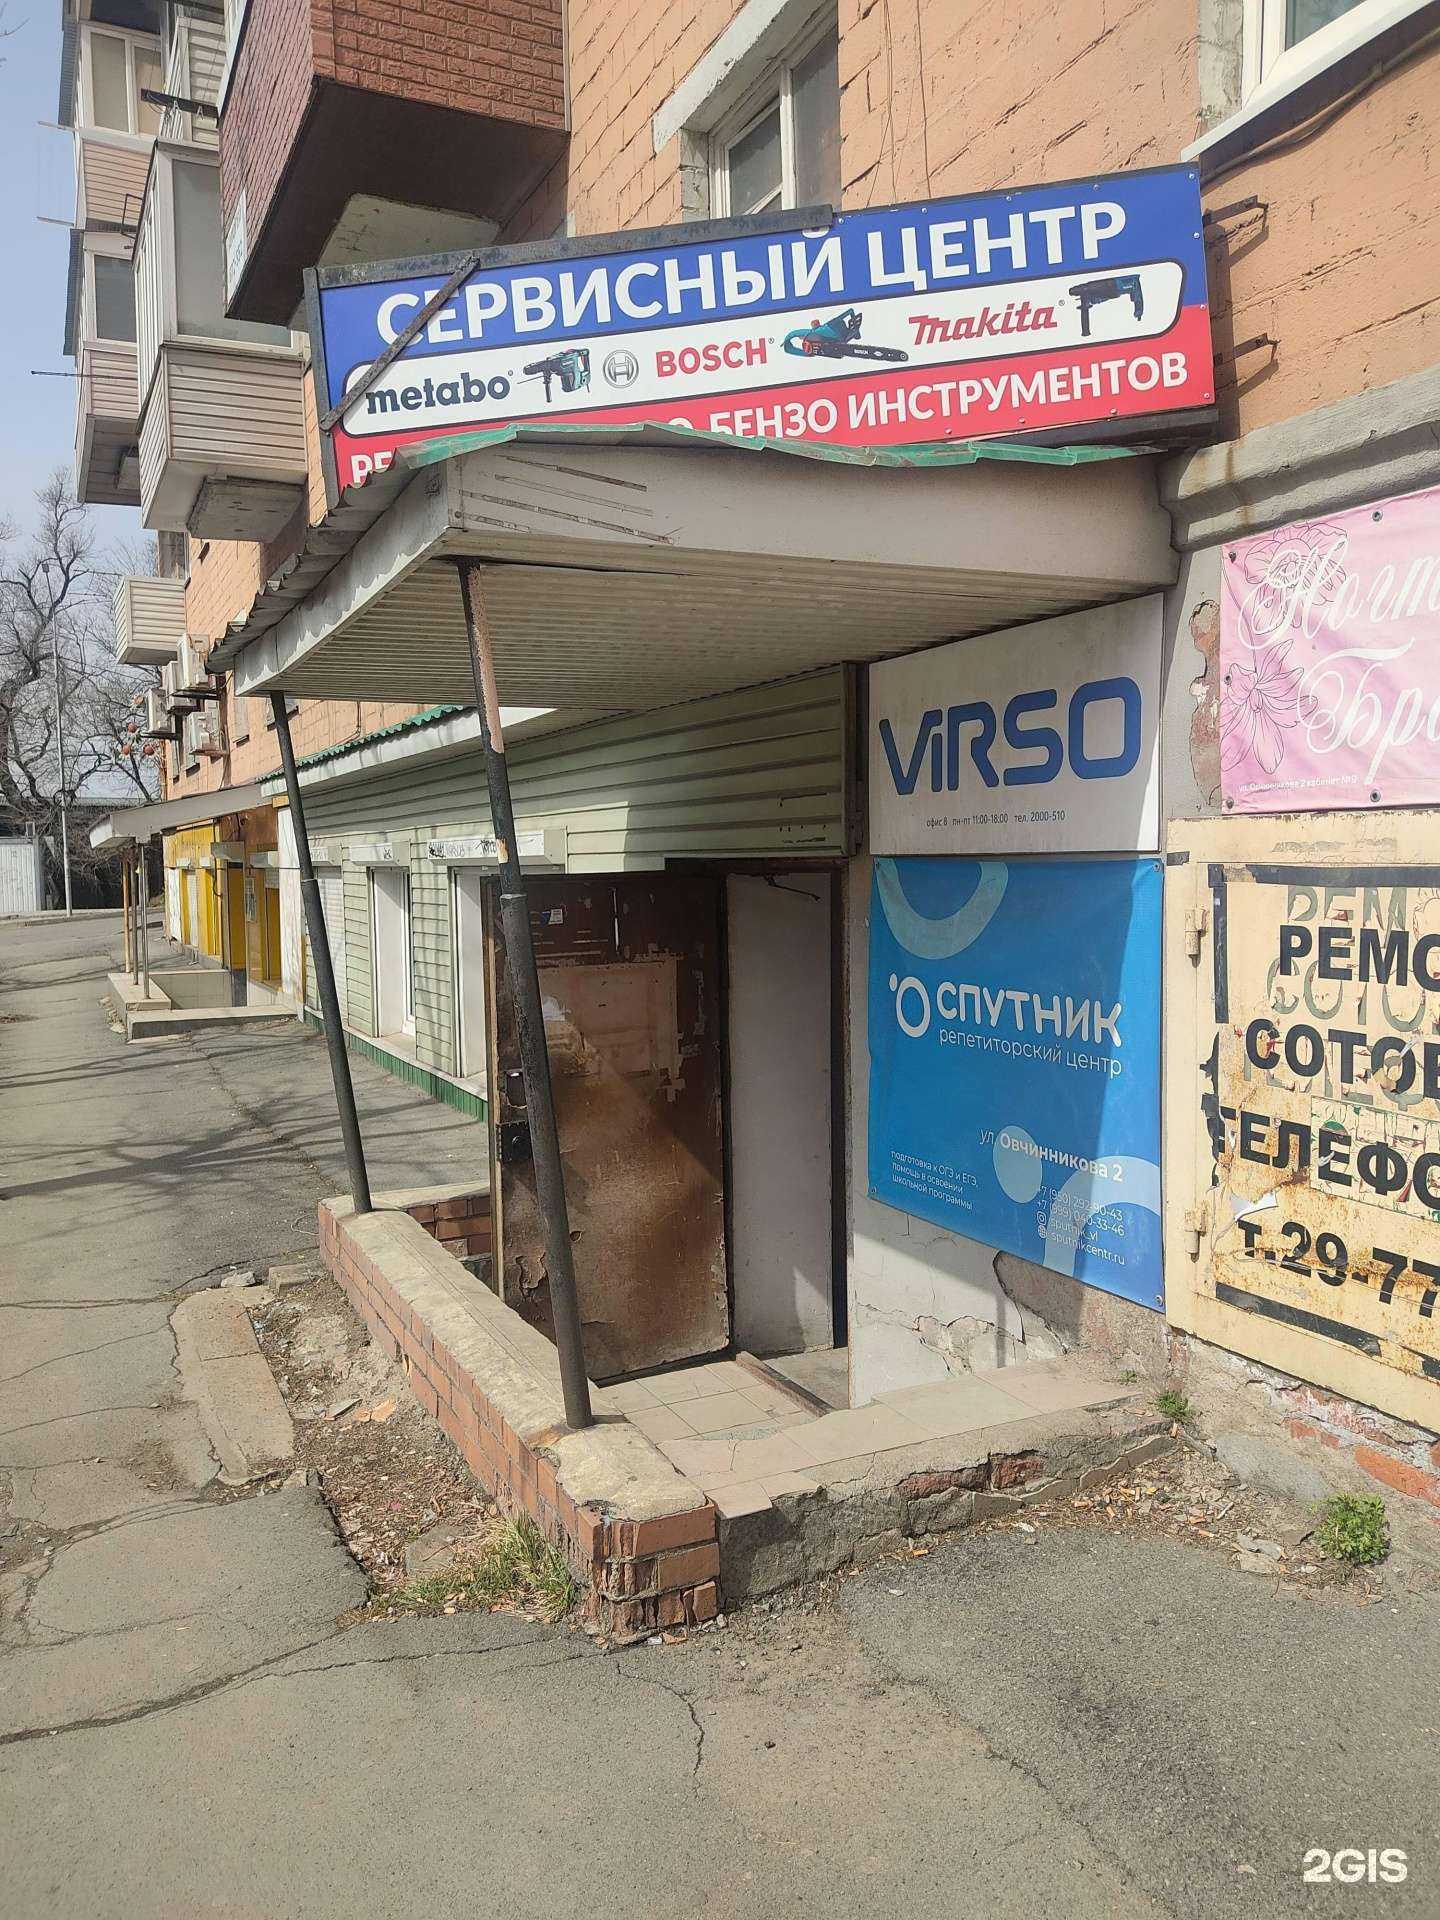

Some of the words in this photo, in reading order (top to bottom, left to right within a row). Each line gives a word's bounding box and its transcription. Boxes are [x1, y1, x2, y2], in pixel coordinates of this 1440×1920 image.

[377, 229, 845, 346] СЕРВИСНЫЙ
[867, 201, 1126, 291] ЦЕНТР
[656, 337, 768, 377] BOSCH
[366, 373, 511, 414] metabo
[710, 399, 838, 438] БЕНЗО
[849, 352, 1189, 429] ИНСТРУМЕНТОВ
[926, 815, 943, 829] офис
[952, 817, 971, 826] пн-пт
[972, 813, 1009, 825] 11:00-18:00
[1014, 814, 1028, 823] тел.
[1030, 810, 1066, 822] 2000-510
[936, 981, 1122, 1047] СПУТНИК
[940, 1028, 1062, 1065] репетиторский
[1066, 1053, 1122, 1079] центр
[890, 1151, 932, 1170] подготовка
[939, 1165, 954, 1178] ОГЭ
[1000, 1132, 1108, 1178] Овчинникова
[1112, 1163, 1123, 1183] 2
[892, 1162, 921, 1179] помощь
[927, 1175, 964, 1195] освоении
[892, 1175, 928, 1193] школьной
[928, 1187, 973, 1210] программы
[1050, 1232, 1125, 1265] sputnikcentr.ru
